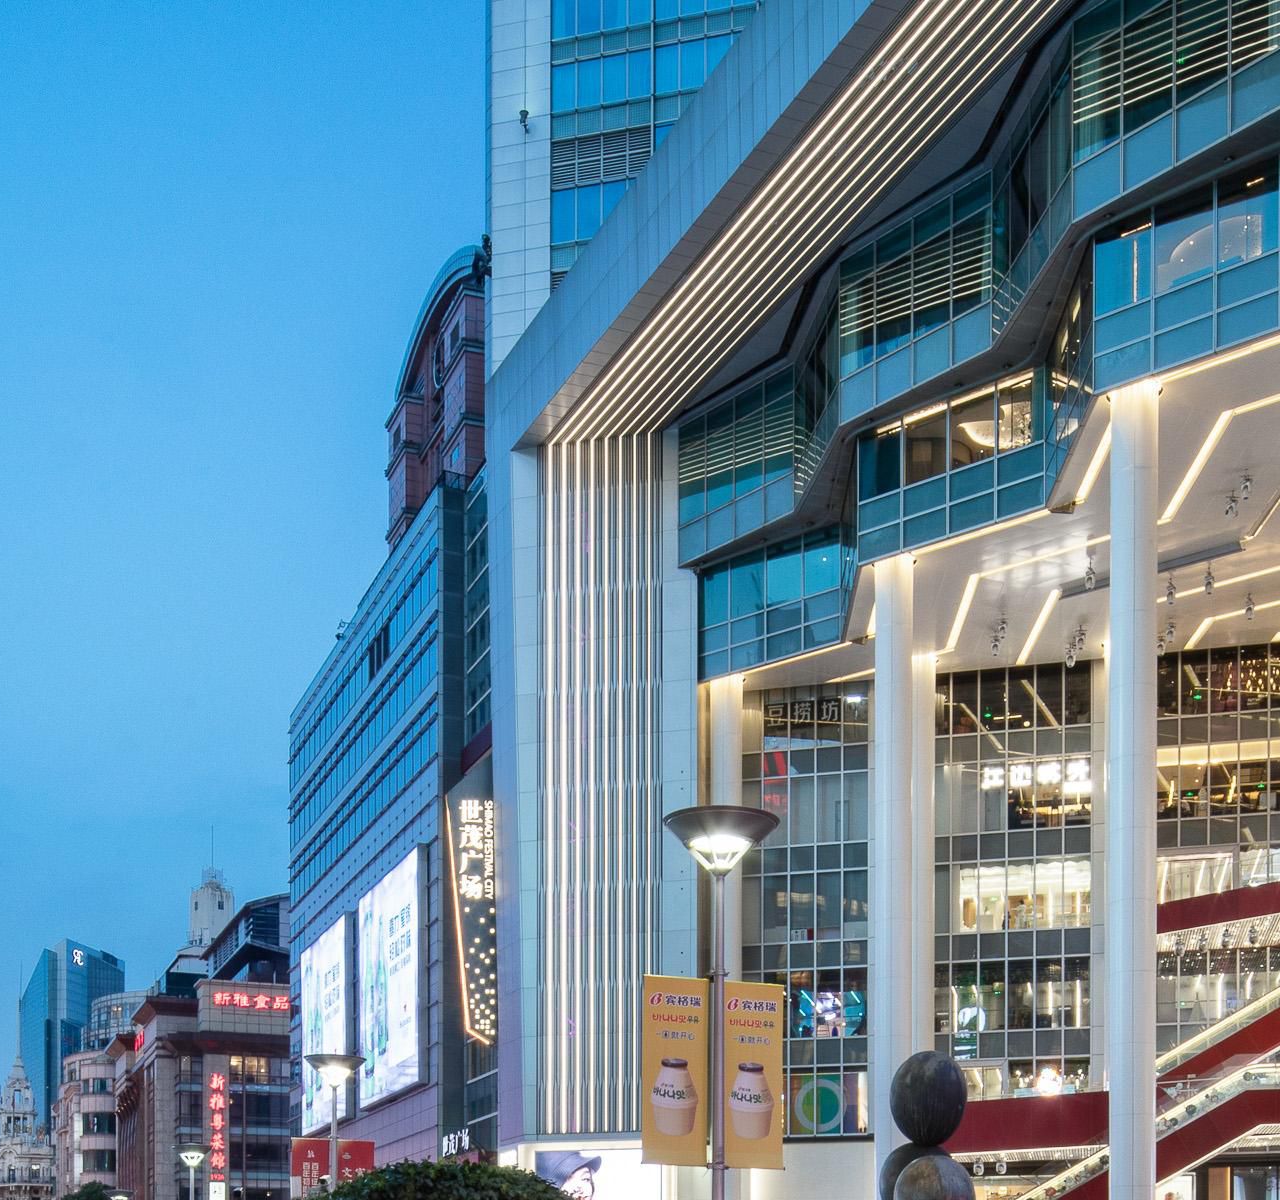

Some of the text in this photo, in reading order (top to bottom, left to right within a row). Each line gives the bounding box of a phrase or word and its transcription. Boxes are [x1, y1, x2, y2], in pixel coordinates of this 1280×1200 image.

[767, 702, 839, 727] 豆捞坊
[459, 800, 484, 899] 世茂广场
[484, 800, 494, 900] SHIMAO FESTIVAL CITY
[213, 991, 291, 1010] 新雅食品
[665, 994, 702, 1007] 宾格瑞
[741, 1000, 777, 1012] 宾格瑞
[209, 1071, 226, 1170] 新雅粤菜馆
[442, 1128, 470, 1158] 世茂广场
